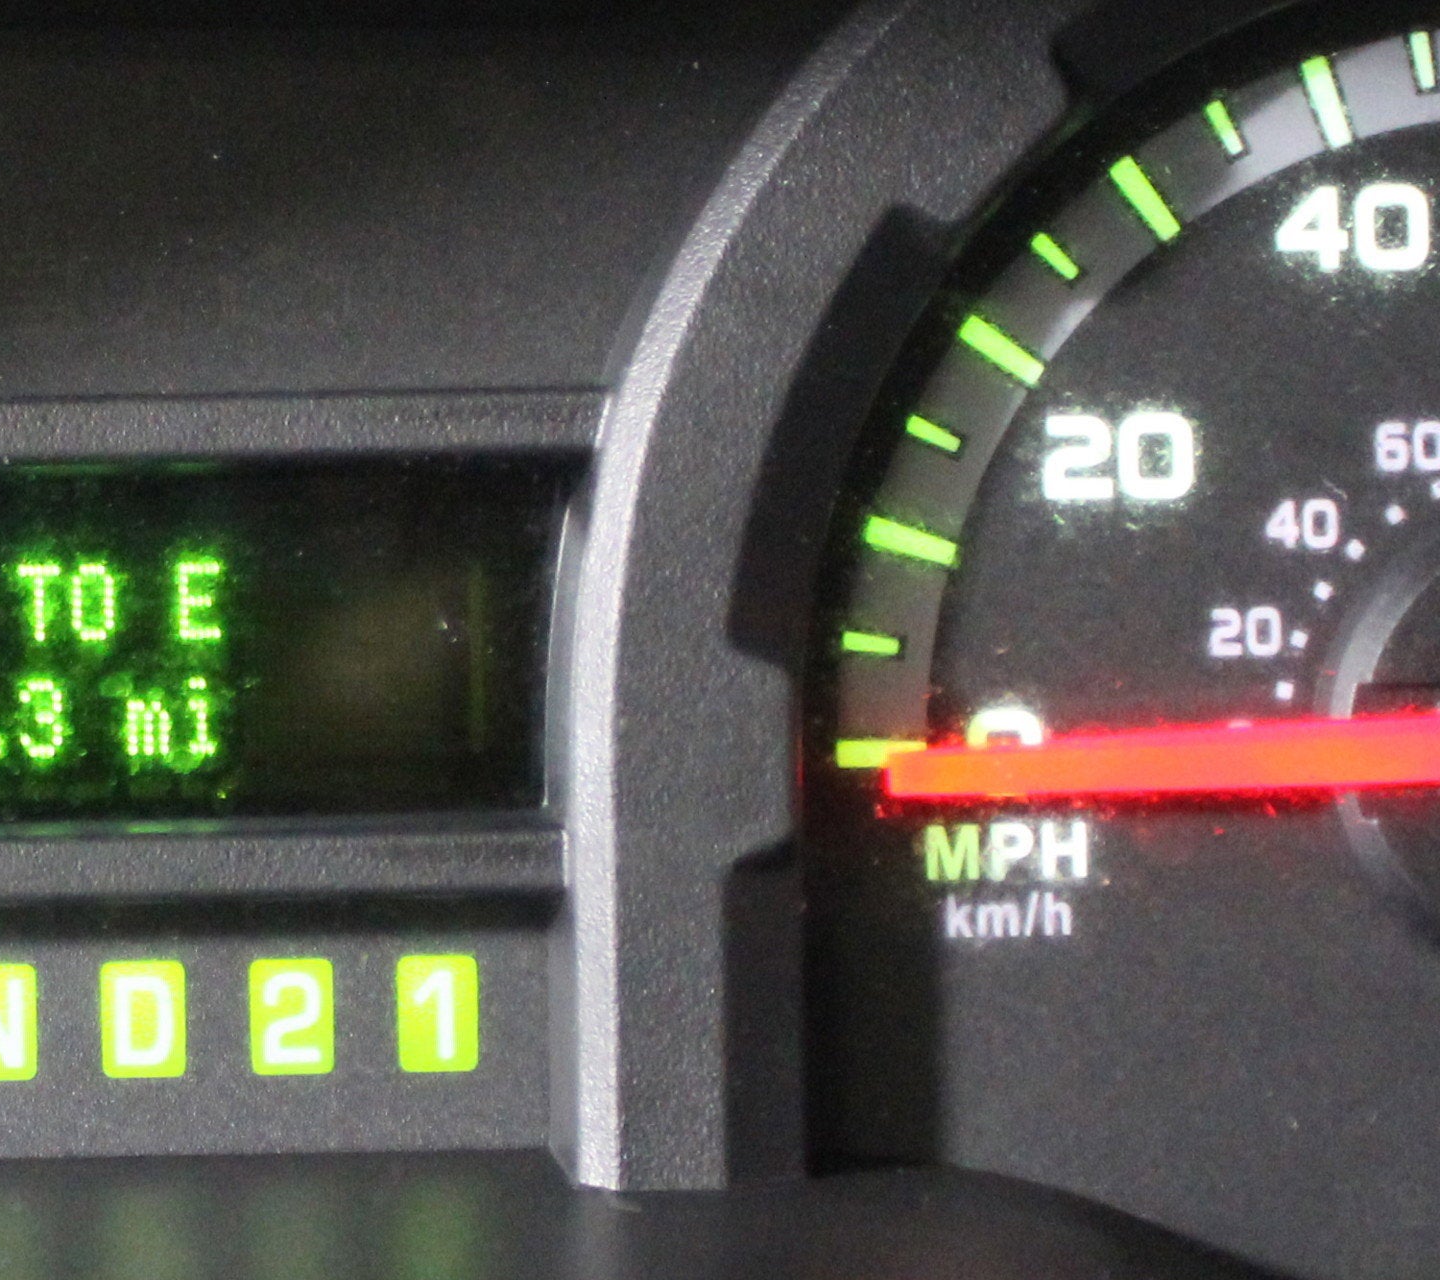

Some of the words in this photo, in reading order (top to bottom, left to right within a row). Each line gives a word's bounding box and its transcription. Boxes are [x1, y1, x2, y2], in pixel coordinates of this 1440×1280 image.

[1275, 180, 1433, 275] 40
[1039, 405, 1199, 506] 20
[1264, 497, 1340, 551] 40
[15, 558, 122, 650] TO
[172, 555, 226, 647] E
[1207, 604, 1284, 659] 20
[116, 676, 220, 766] mi
[926, 819, 1090, 882] MPH
[945, 891, 1073, 939] km/h
[114, 974, 175, 1067] D
[262, 970, 323, 1064] 2
[414, 969, 455, 1061] 1
